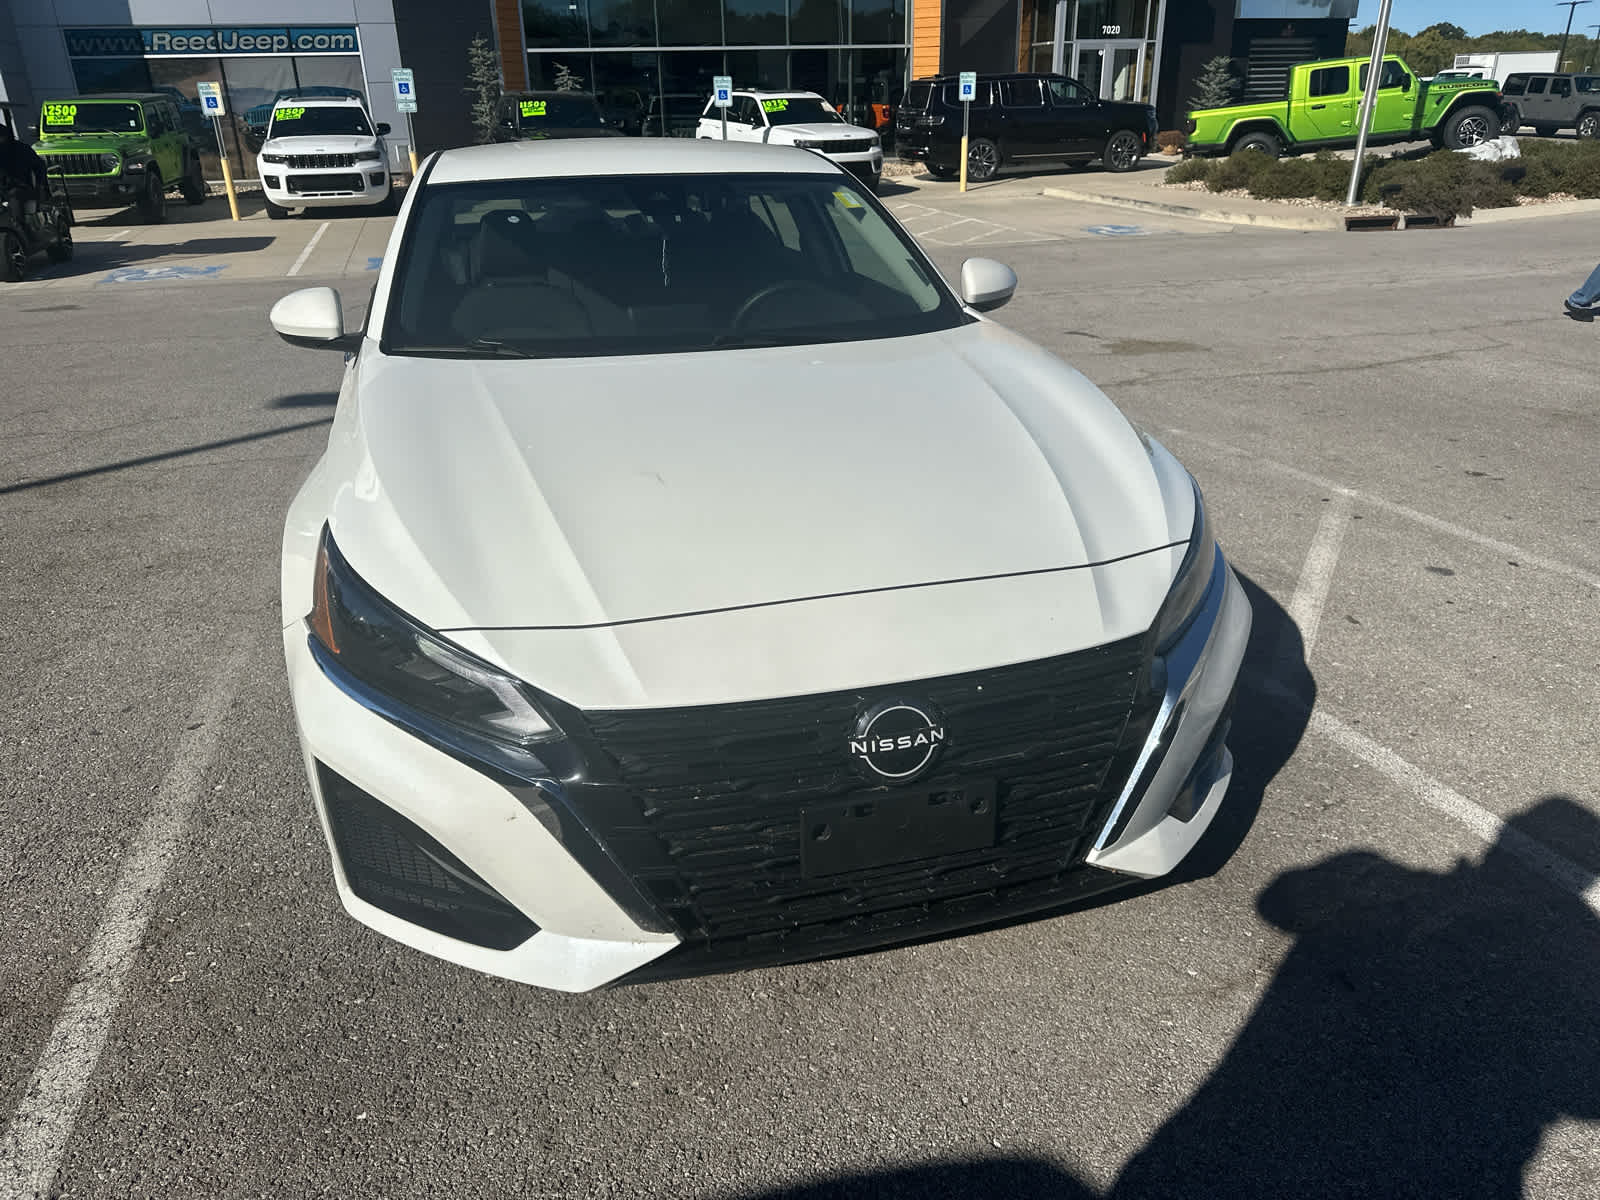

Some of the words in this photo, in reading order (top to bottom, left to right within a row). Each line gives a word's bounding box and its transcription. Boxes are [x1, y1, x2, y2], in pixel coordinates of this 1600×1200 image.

[1102, 25, 1120, 34] 7020
[71, 31, 354, 53] www.ReedJeep.com
[43, 105, 77, 116] 12500
[851, 727, 944, 754] NISSAN
